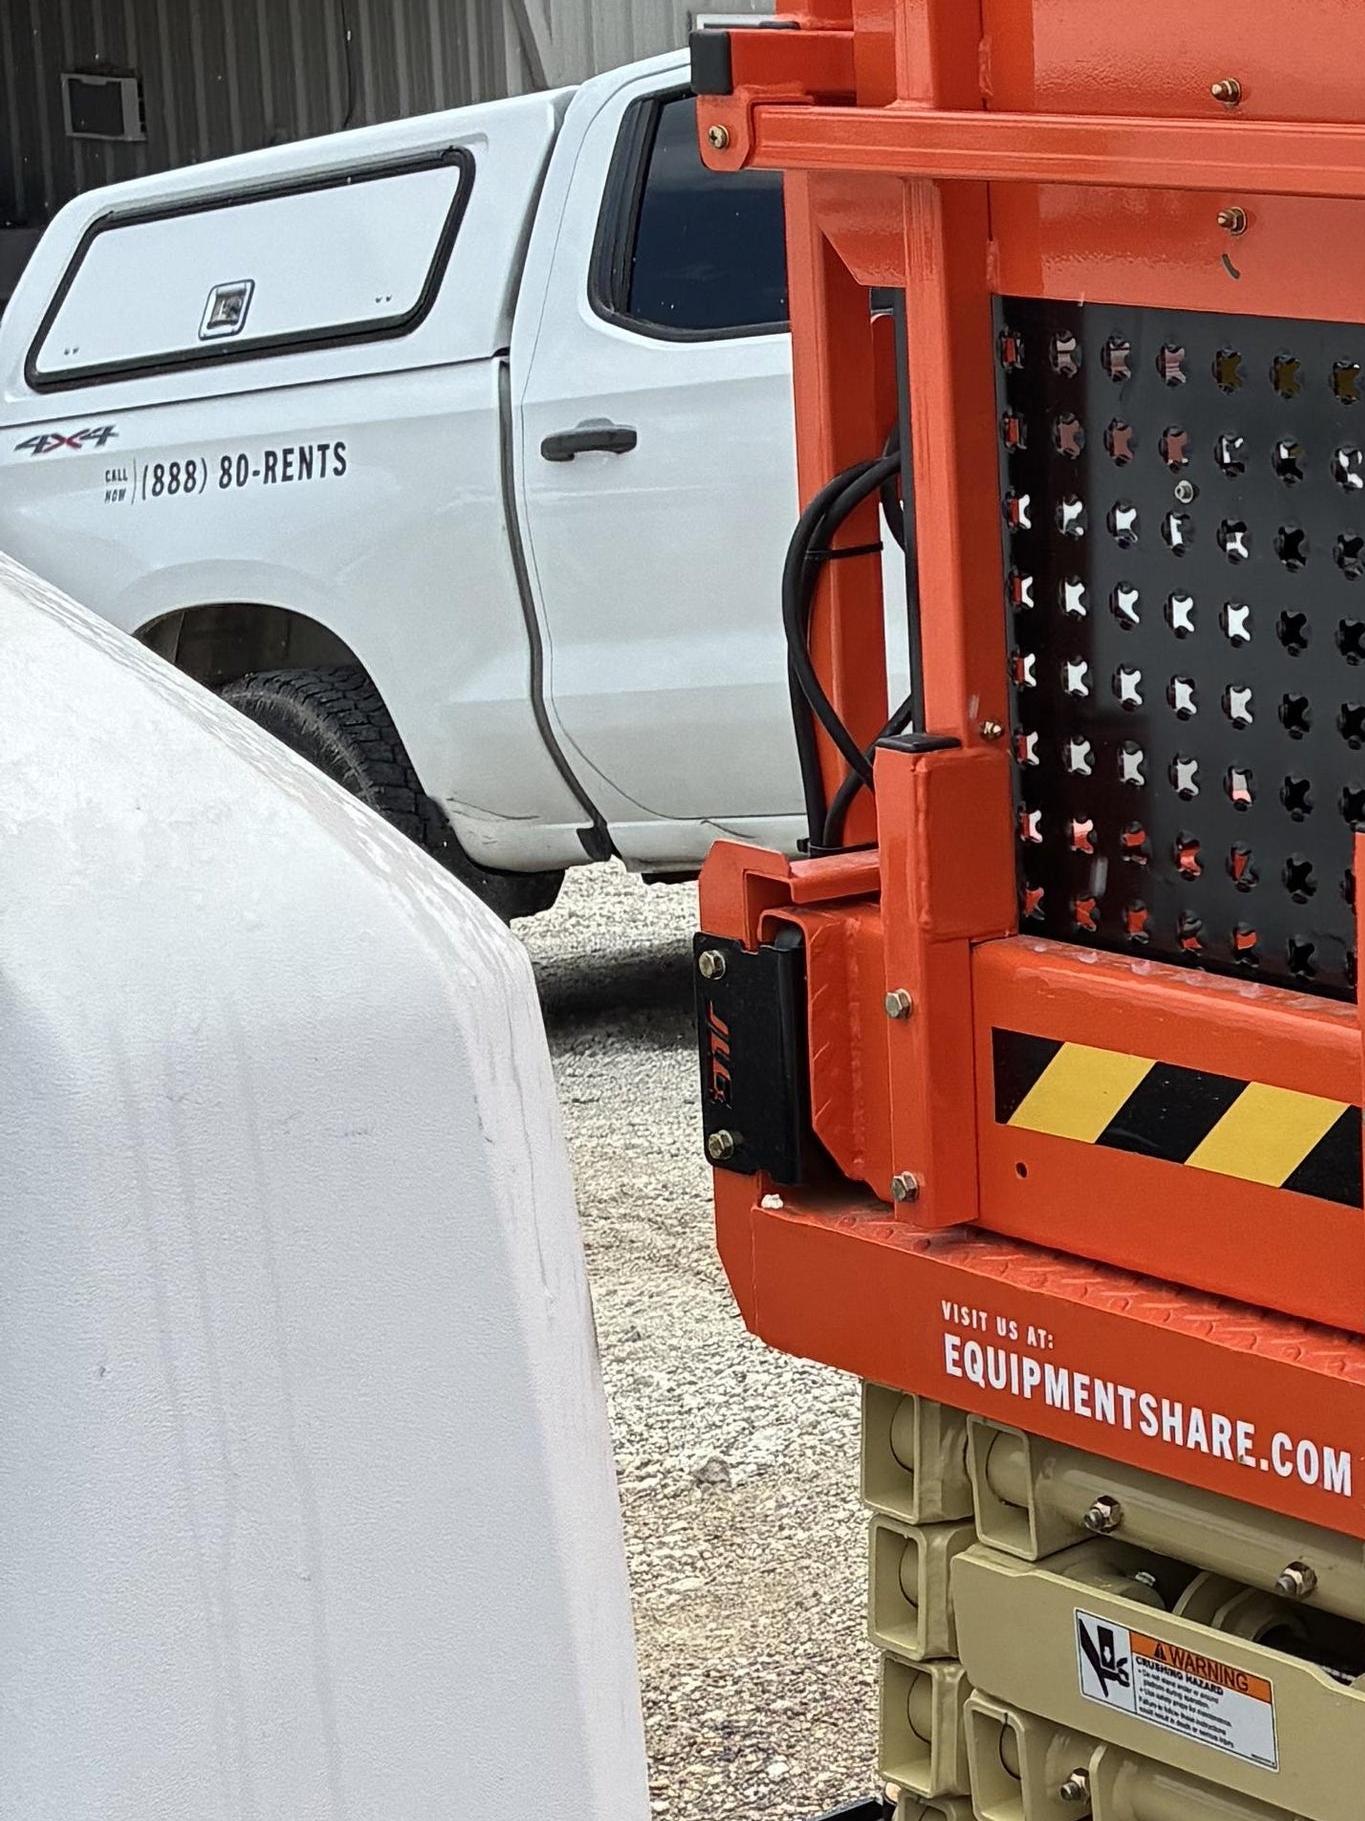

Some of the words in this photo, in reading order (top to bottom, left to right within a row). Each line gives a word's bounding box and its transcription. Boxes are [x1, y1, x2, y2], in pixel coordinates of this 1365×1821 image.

[105, 468, 128, 483] CALL
[142, 457, 208, 501] (888)
[218, 441, 347, 490] 80-RENTS
[104, 489, 127, 504] NOW
[942, 1300, 987, 1332] VISIT
[997, 1315, 1018, 1340] US
[1027, 1326, 1054, 1350] AT:
[944, 1332, 1352, 1498] EQUIPMENTSHARE.COM
[1135, 1656, 1183, 1680] CRUSHING
[1185, 1674, 1223, 1695] HAZARD
[1168, 1646, 1249, 1692] WARNING
